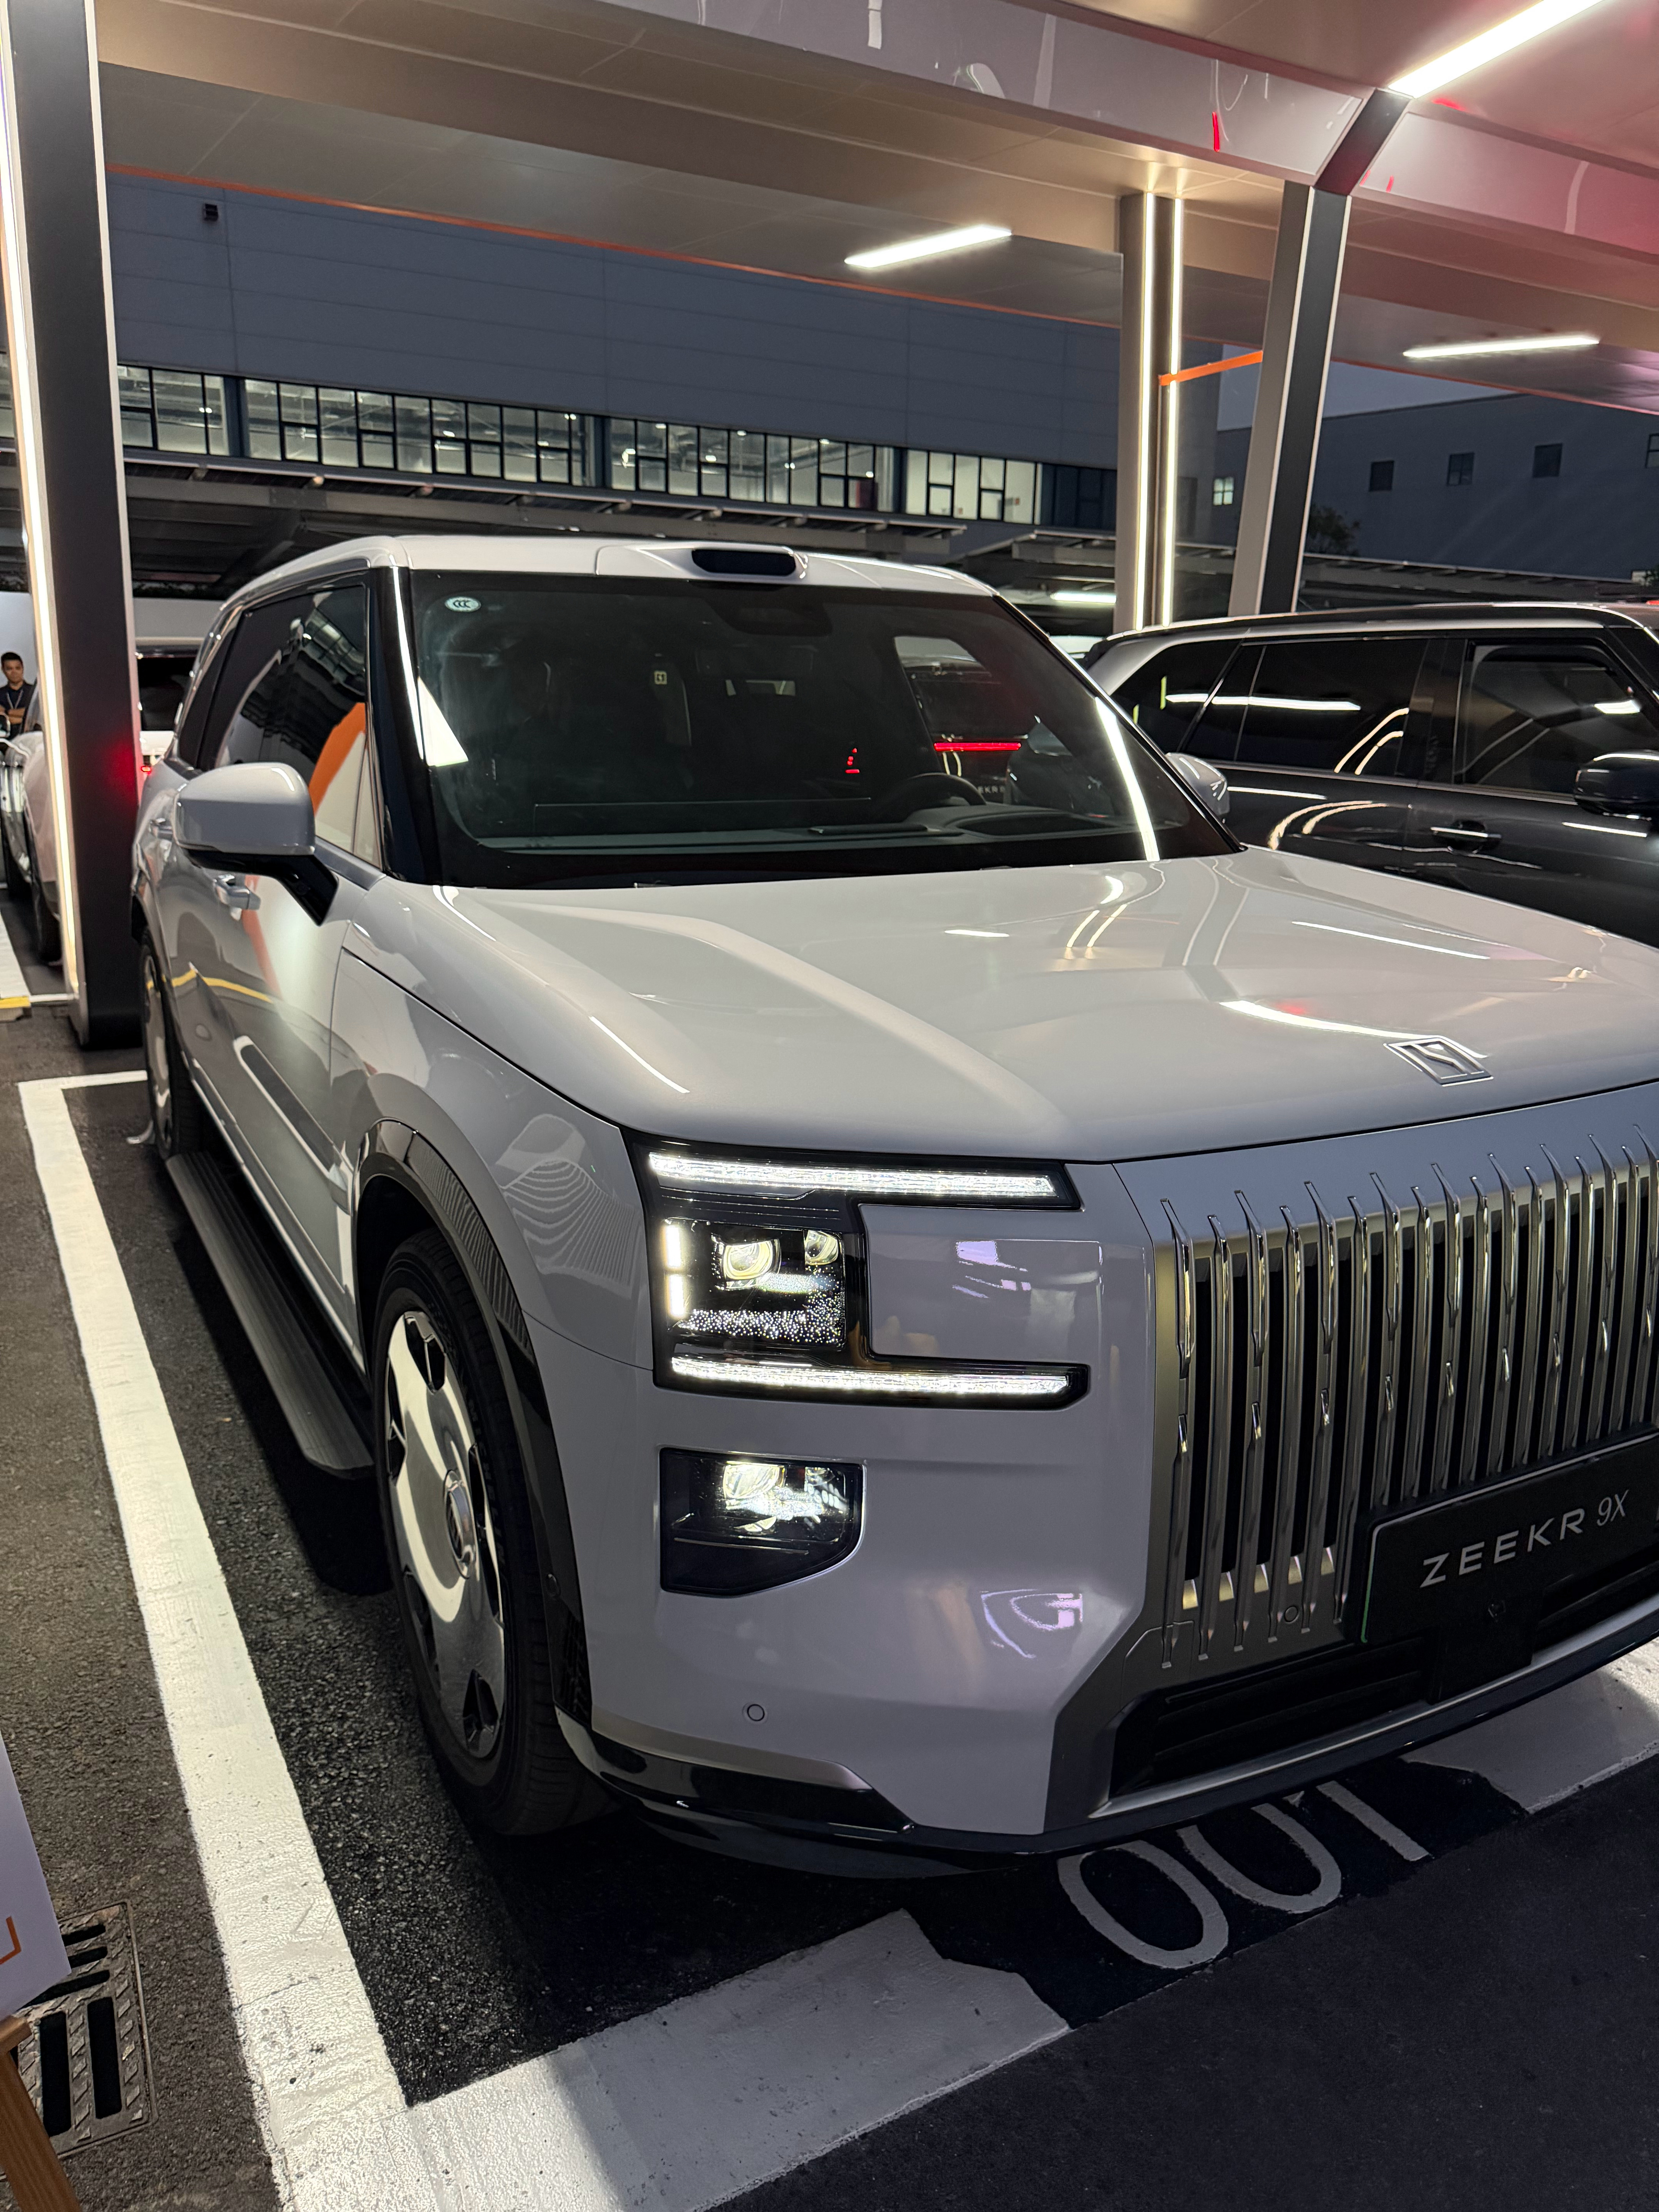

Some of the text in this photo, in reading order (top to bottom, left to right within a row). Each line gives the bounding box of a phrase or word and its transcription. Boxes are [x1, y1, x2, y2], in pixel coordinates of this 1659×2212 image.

[468, 1398, 506, 1566] MICHELIN
[1420, 1489, 1629, 1588] ZEEKR 9X
